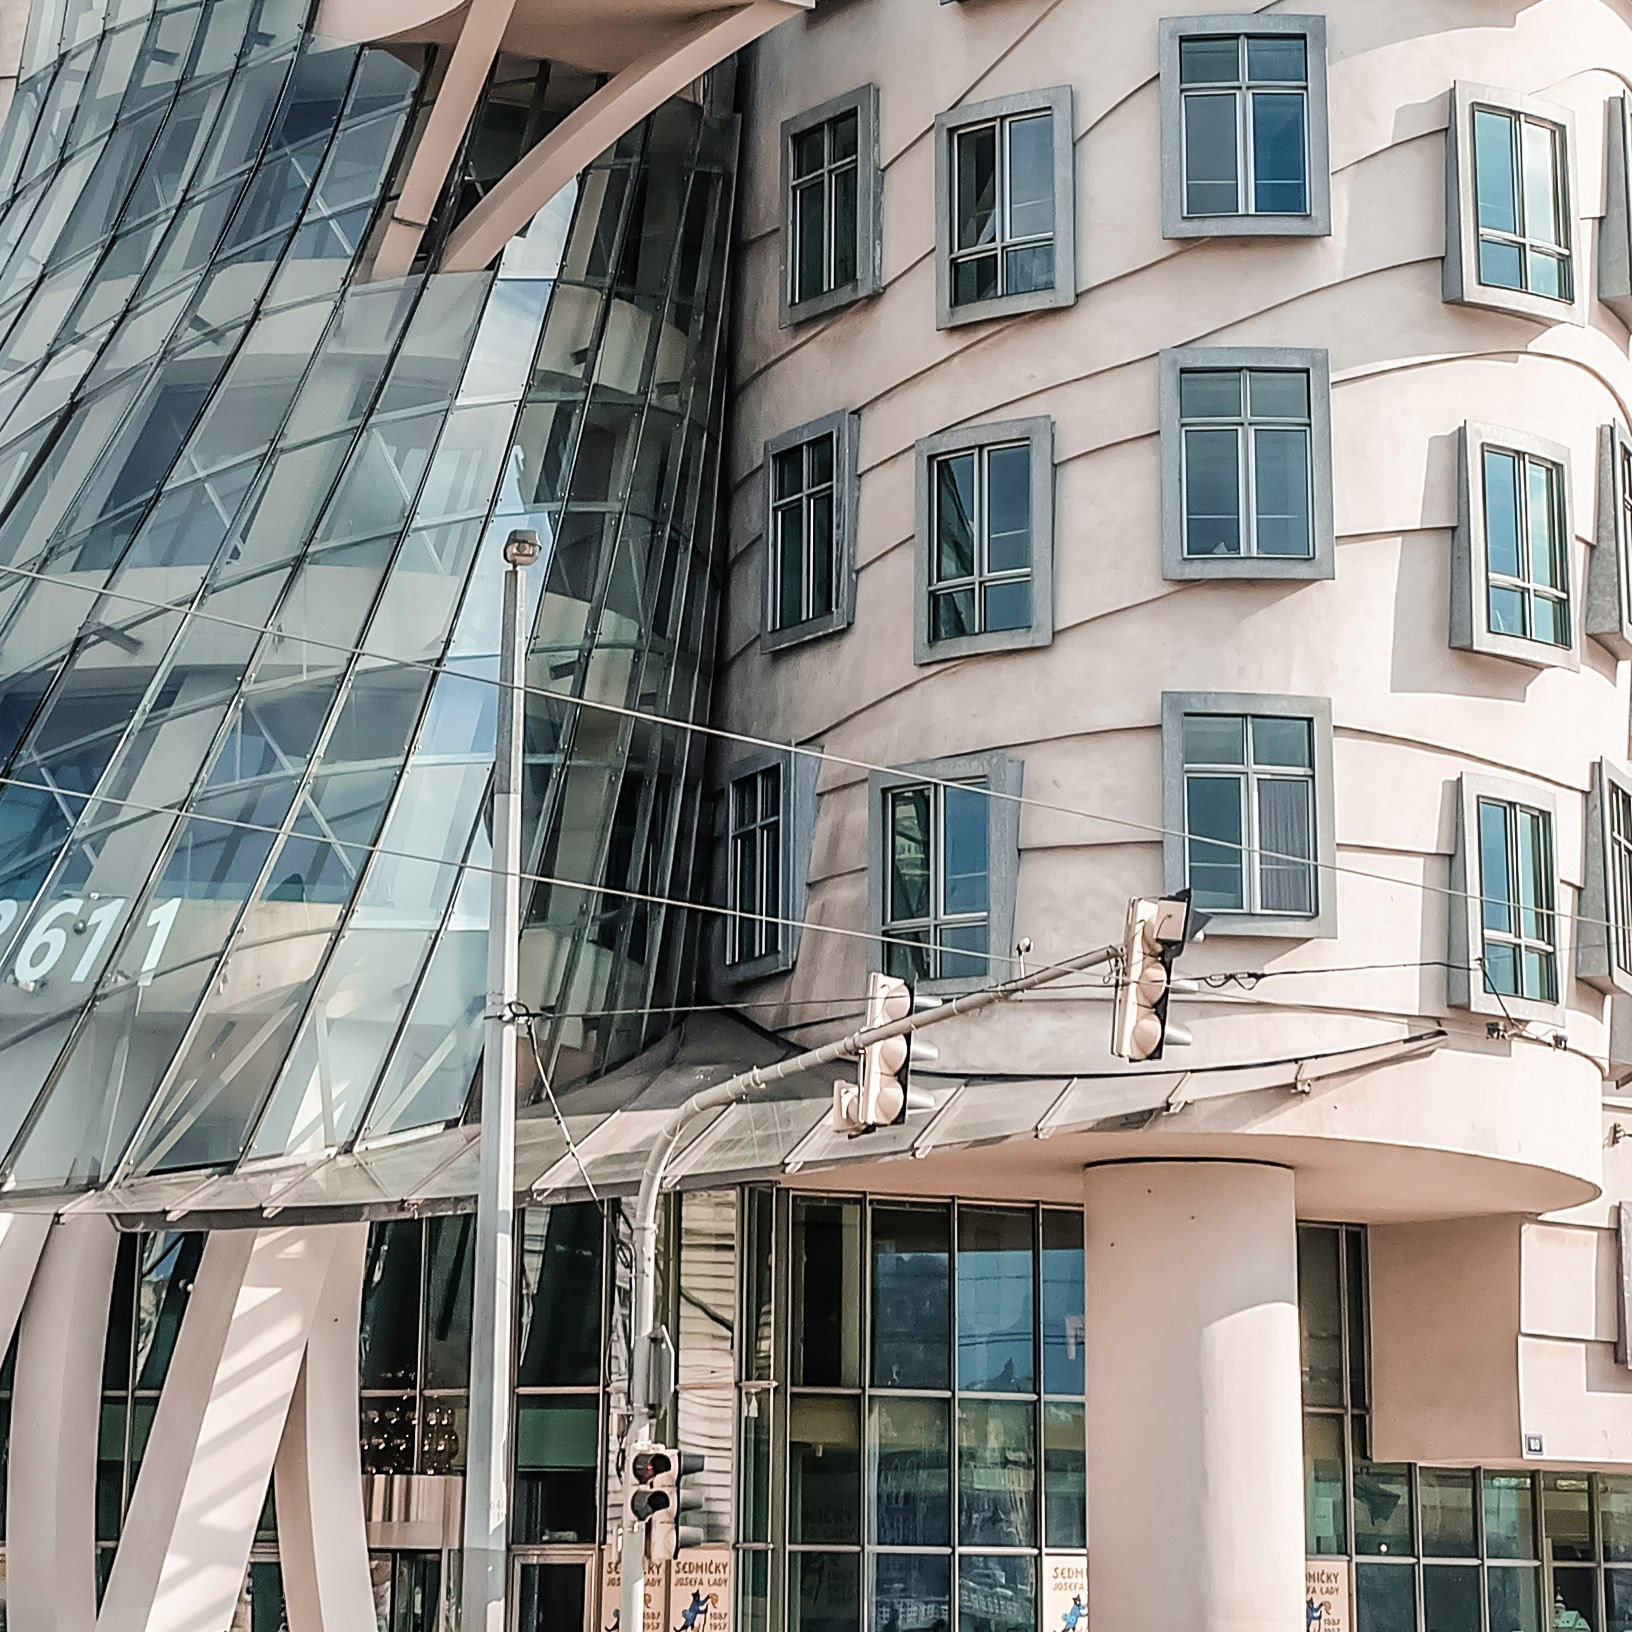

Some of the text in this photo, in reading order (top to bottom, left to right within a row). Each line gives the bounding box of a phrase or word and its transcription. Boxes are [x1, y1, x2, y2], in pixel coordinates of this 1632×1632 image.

[674, 1559, 729, 1575] SEDMIČKY
[1052, 1567, 1084, 1579] SEDM
[708, 1577, 729, 1587] LADY
[1307, 1569, 1340, 1584] MIČKY
